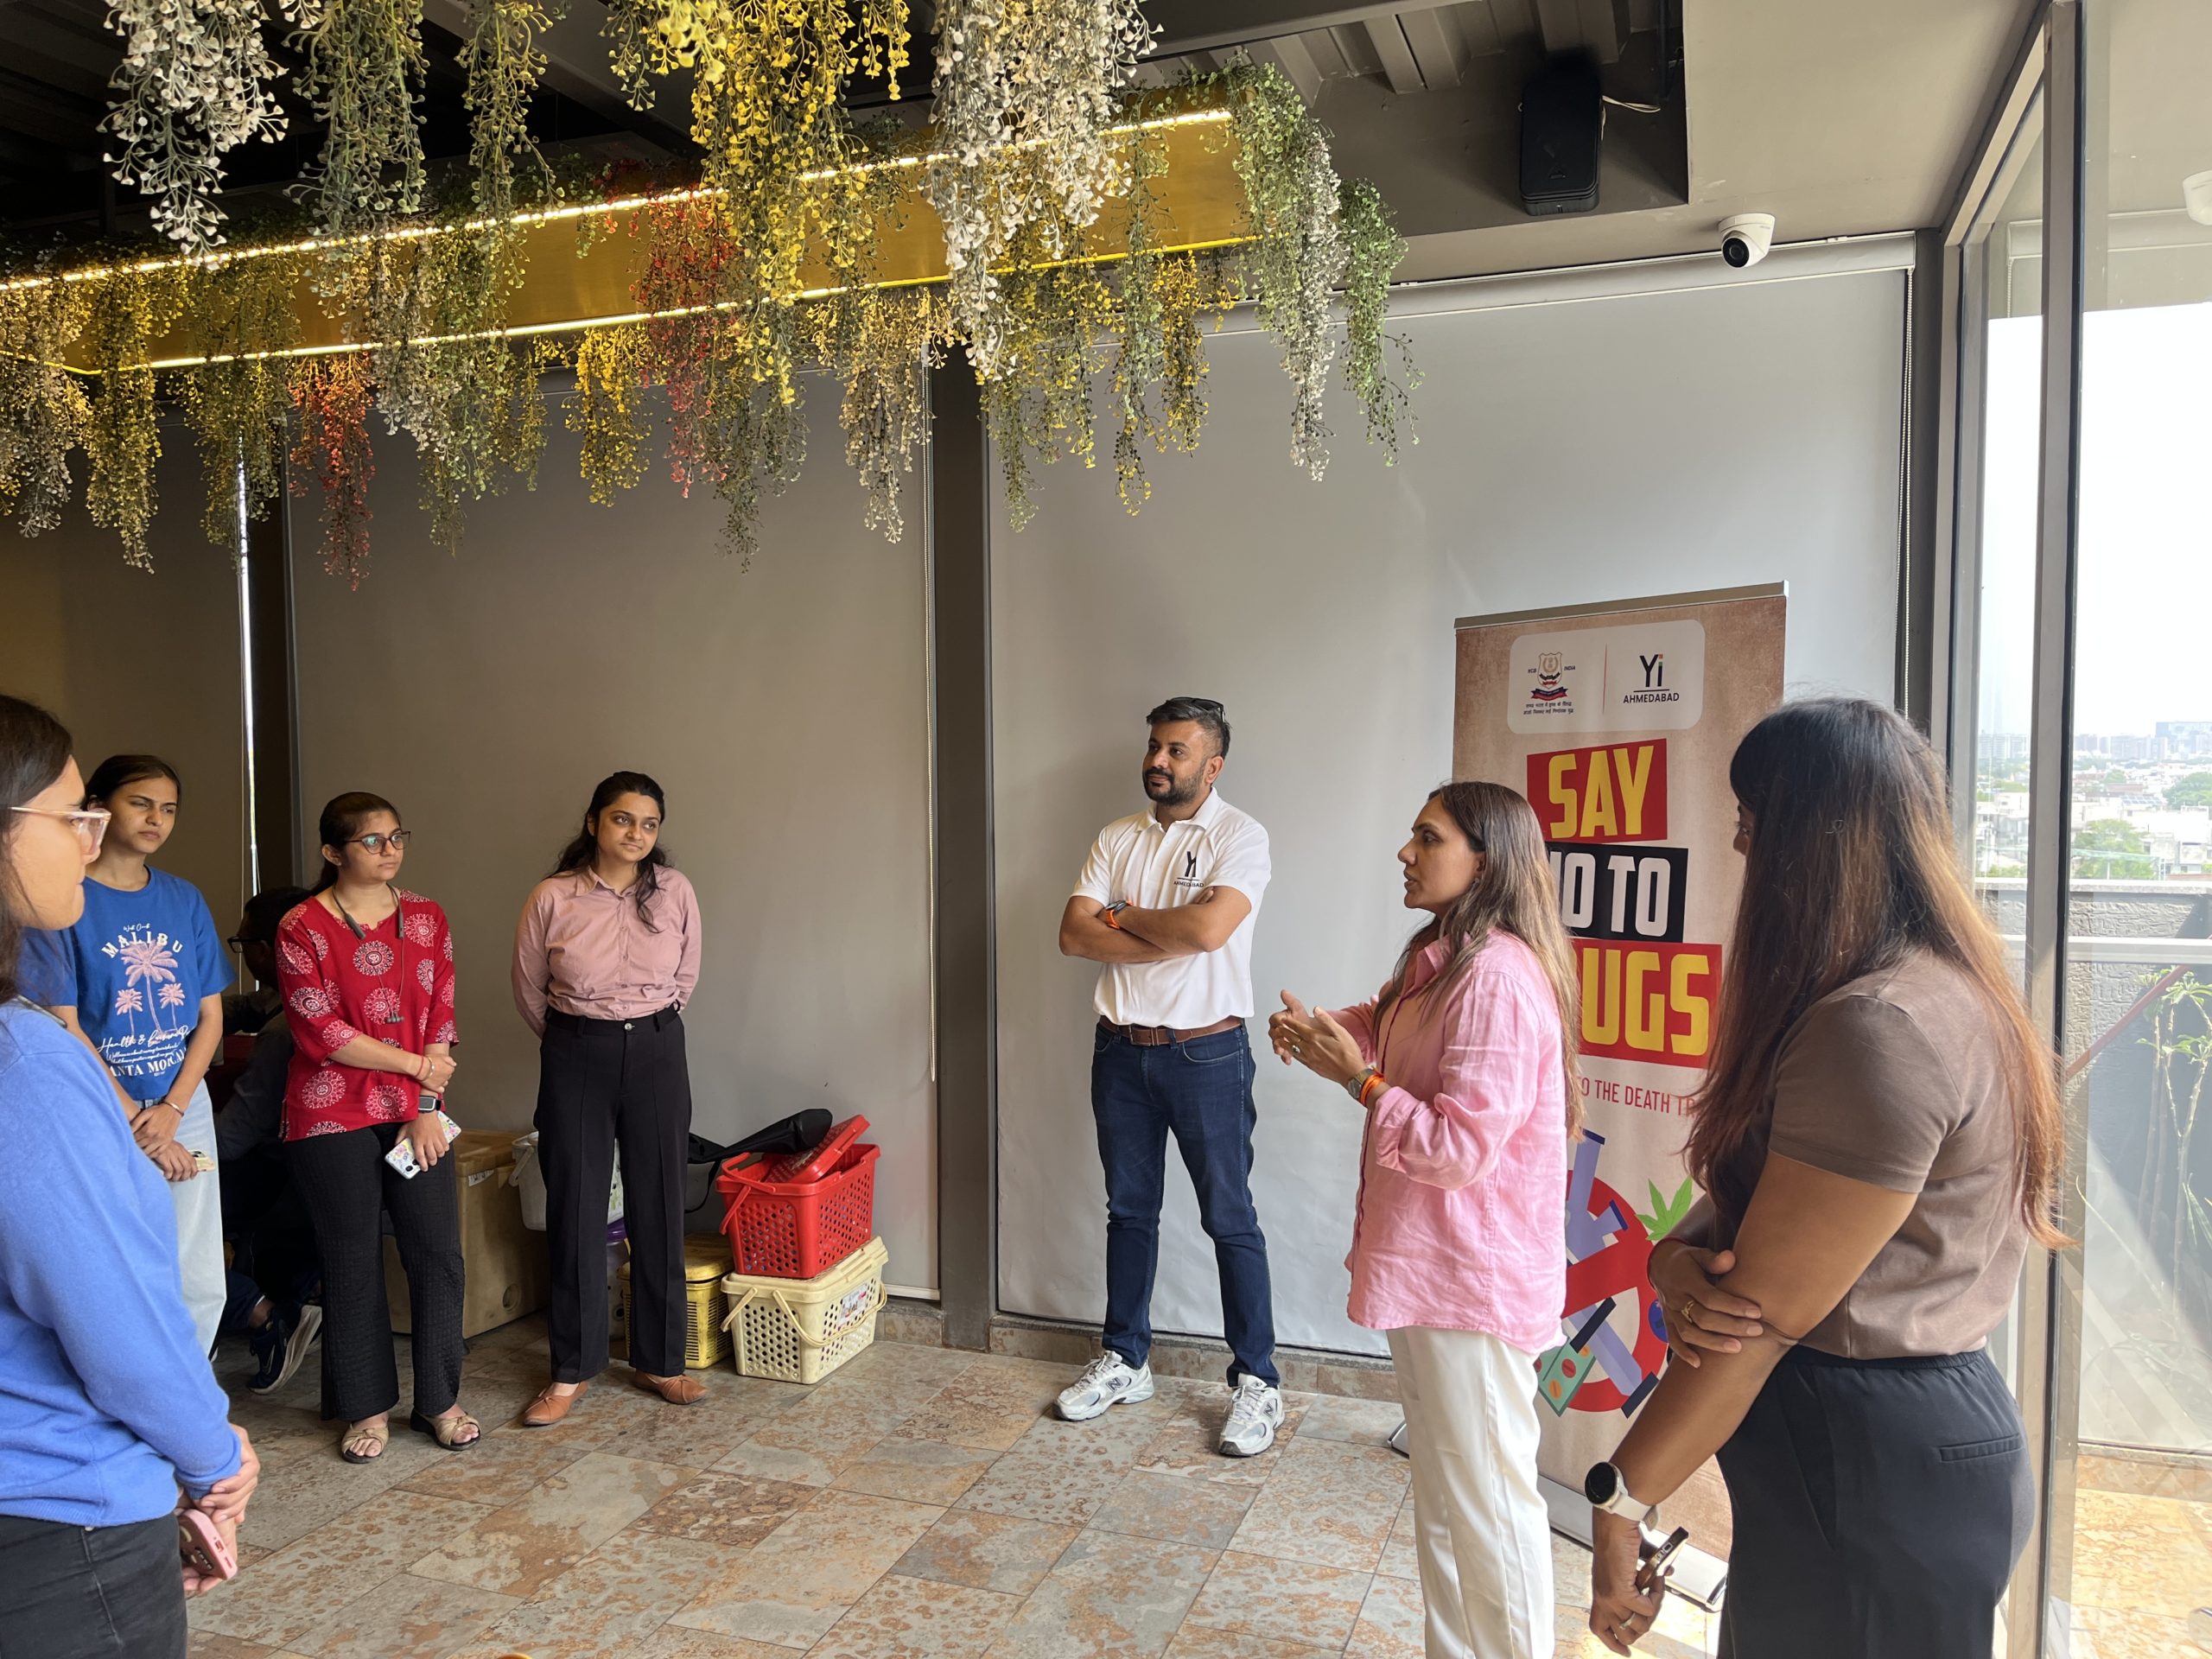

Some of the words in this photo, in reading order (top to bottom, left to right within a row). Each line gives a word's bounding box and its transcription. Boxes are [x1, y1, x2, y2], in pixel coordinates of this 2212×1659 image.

[1639, 653, 1663, 688] Yi
[1623, 692, 1680, 703] AHMEDABAD
[1548, 745, 1655, 839] SAY
[1607, 855, 1671, 937] TO
[101, 931, 183, 959] MALIBU
[1581, 947, 1710, 1056] UGS
[1594, 1079, 1620, 1103] THE
[1624, 1085, 1670, 1114] DEATH
